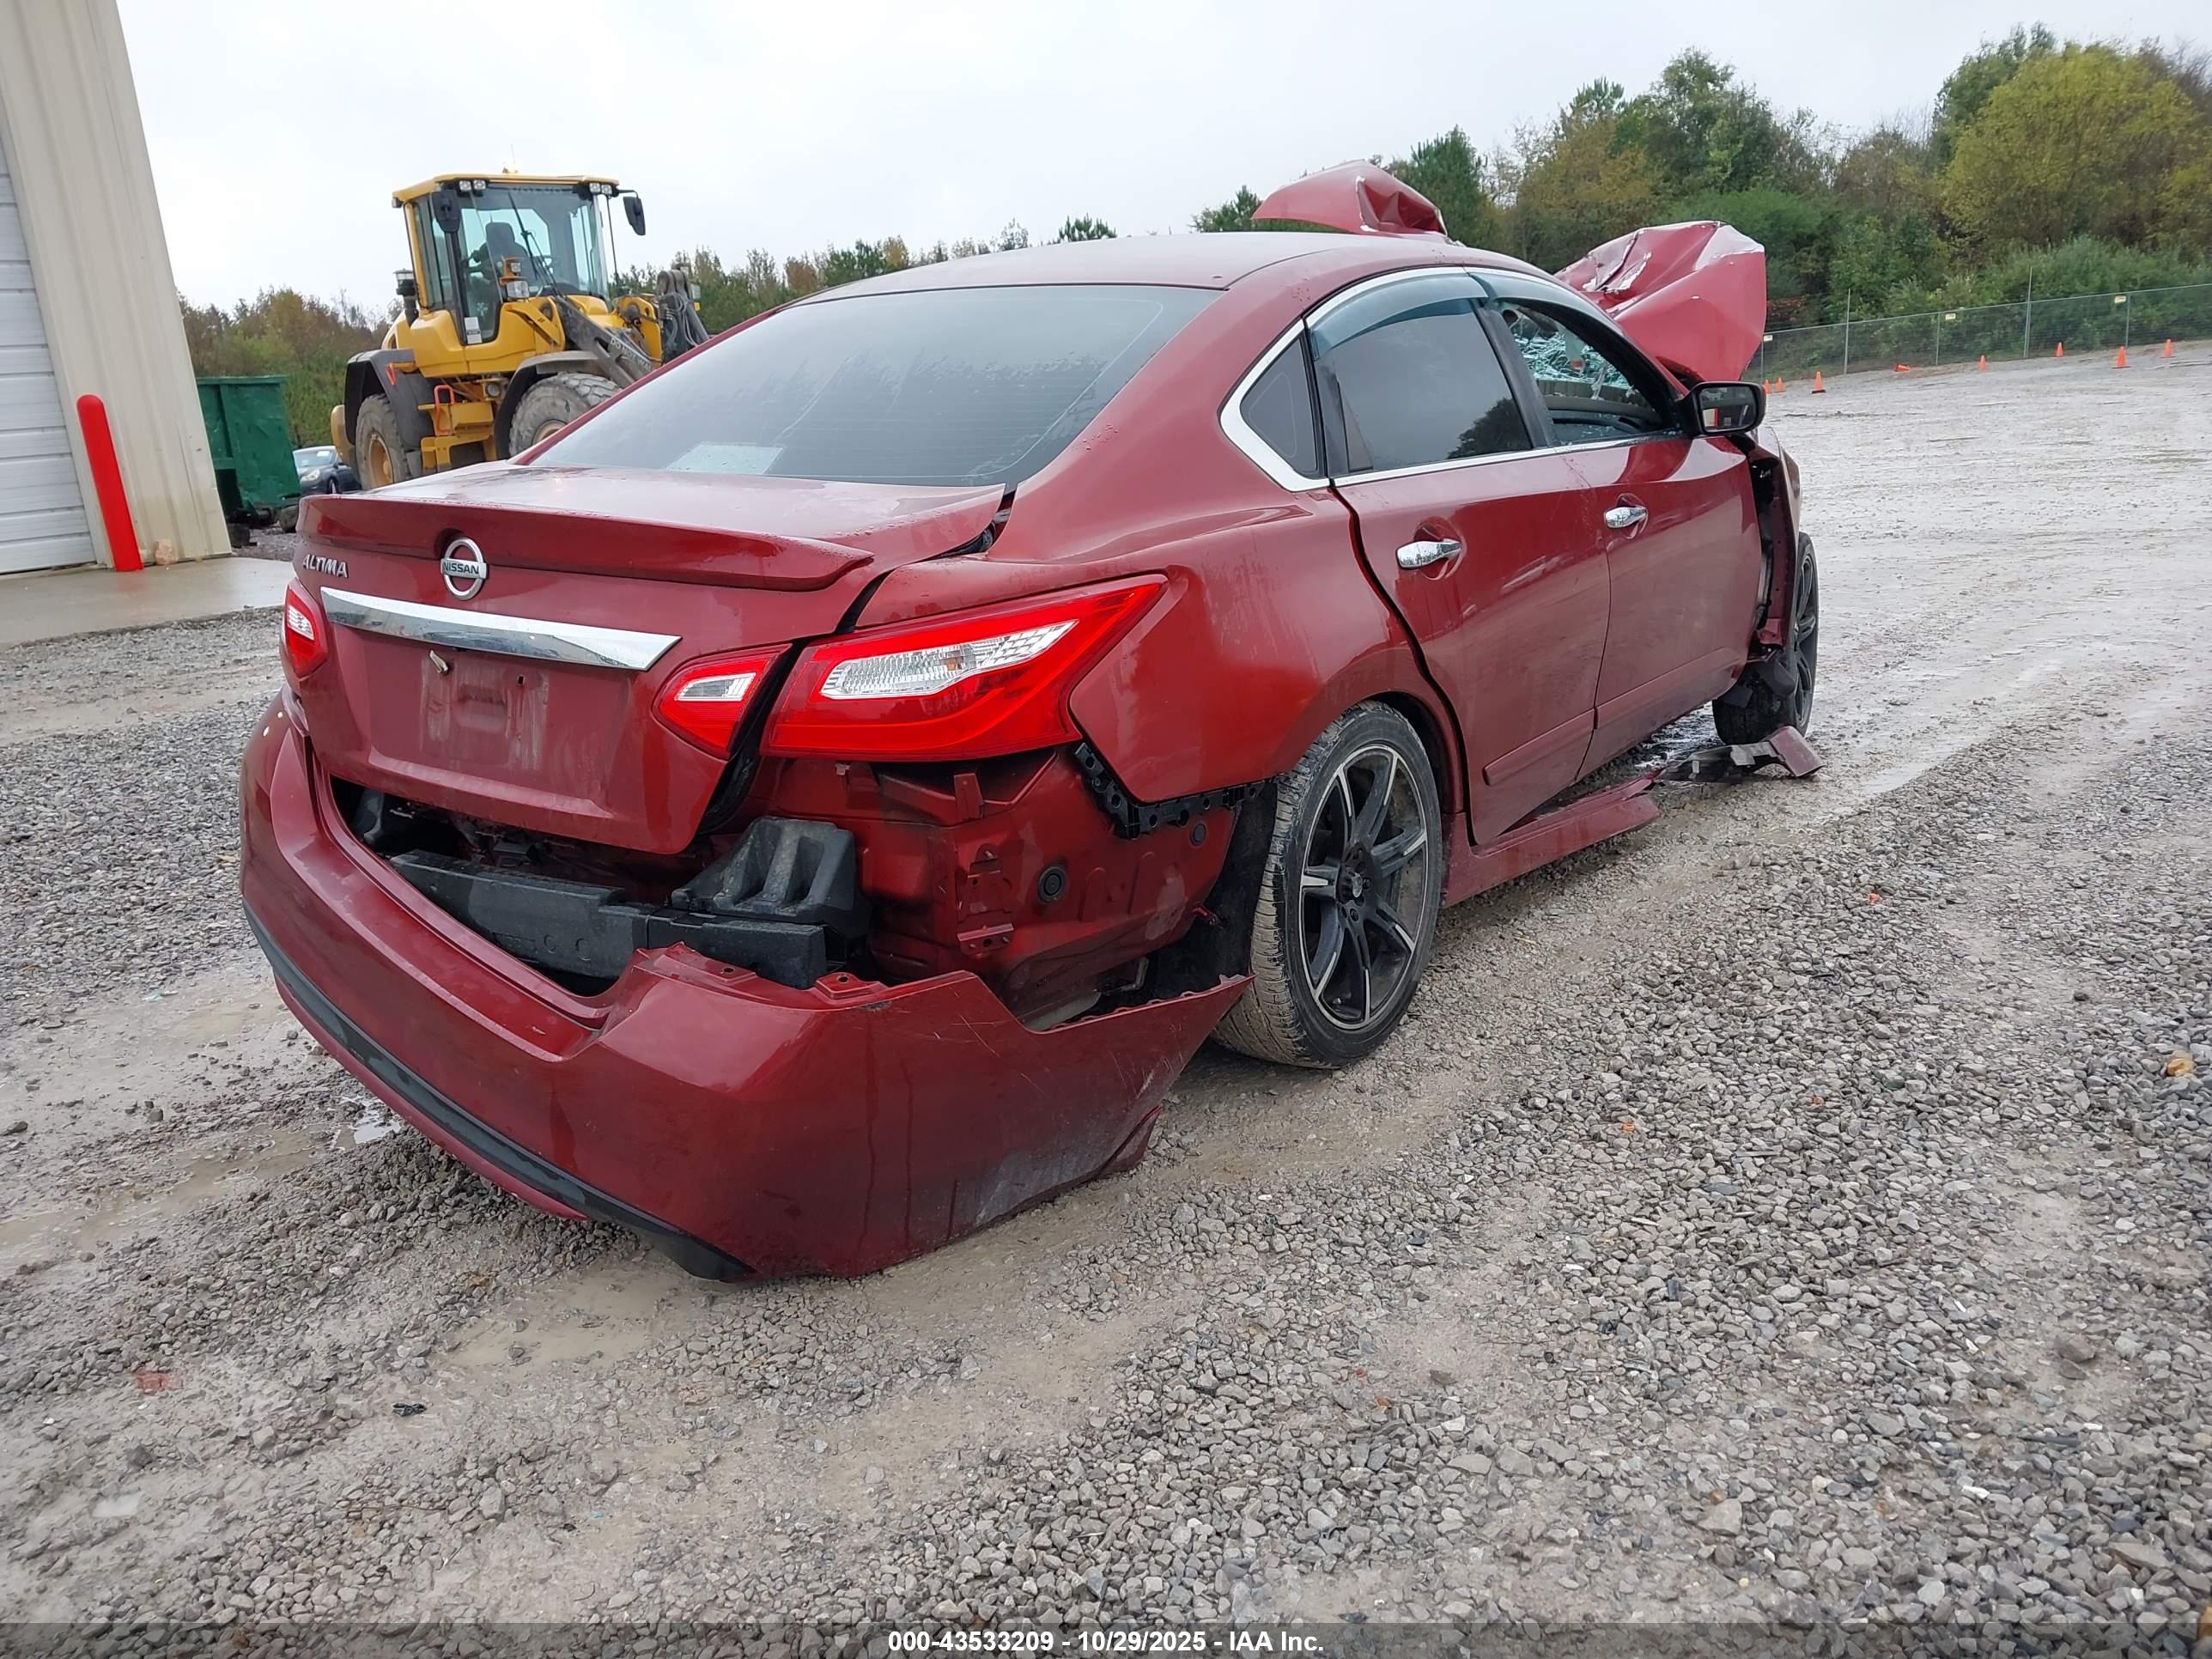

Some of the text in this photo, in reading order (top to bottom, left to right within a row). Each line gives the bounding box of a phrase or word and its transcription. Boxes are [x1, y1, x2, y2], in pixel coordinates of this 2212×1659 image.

[611, 337, 621, 349] DO
[302, 553, 348, 579] ALTIMA
[443, 562, 480, 574] NISSAN
